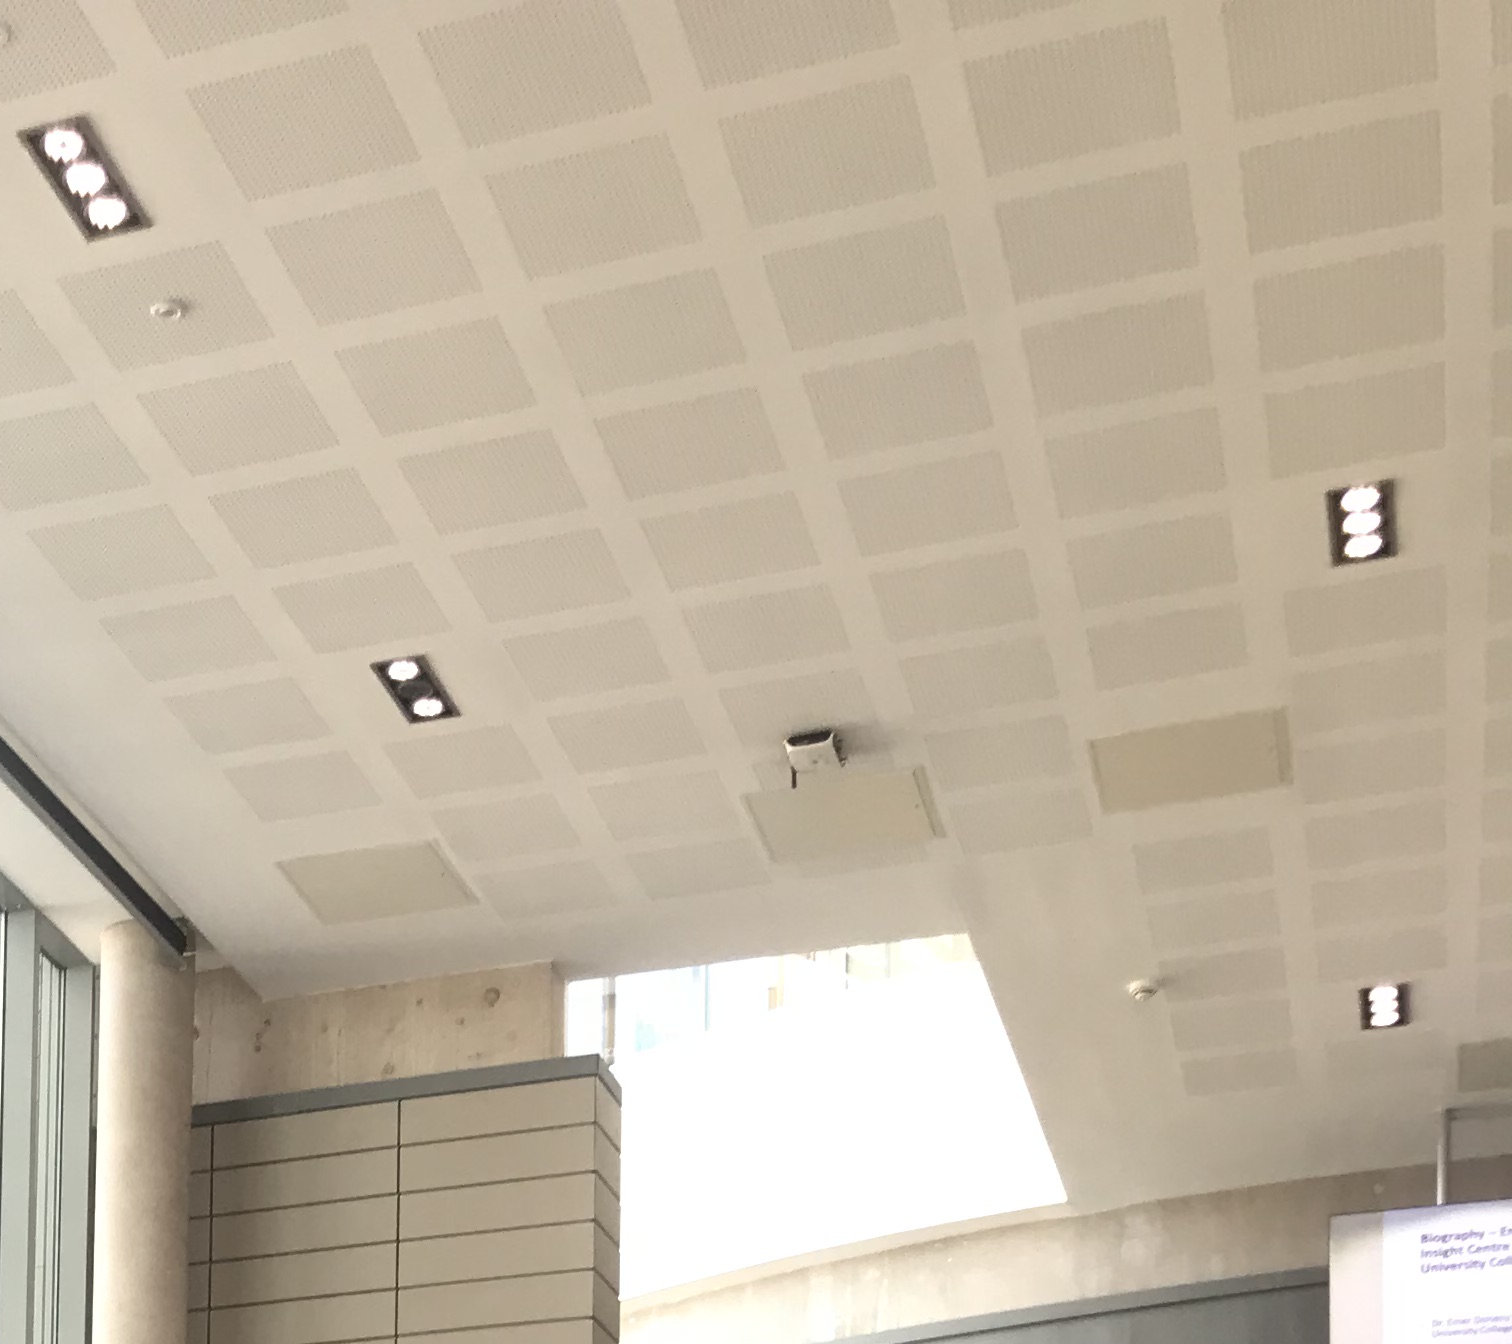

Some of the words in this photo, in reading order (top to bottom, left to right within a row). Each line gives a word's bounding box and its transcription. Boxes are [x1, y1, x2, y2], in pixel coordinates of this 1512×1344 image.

[1420, 1229, 1485, 1244] Biography
[1420, 1246, 1464, 1259] Insight
[1420, 1260, 1486, 1274] University
